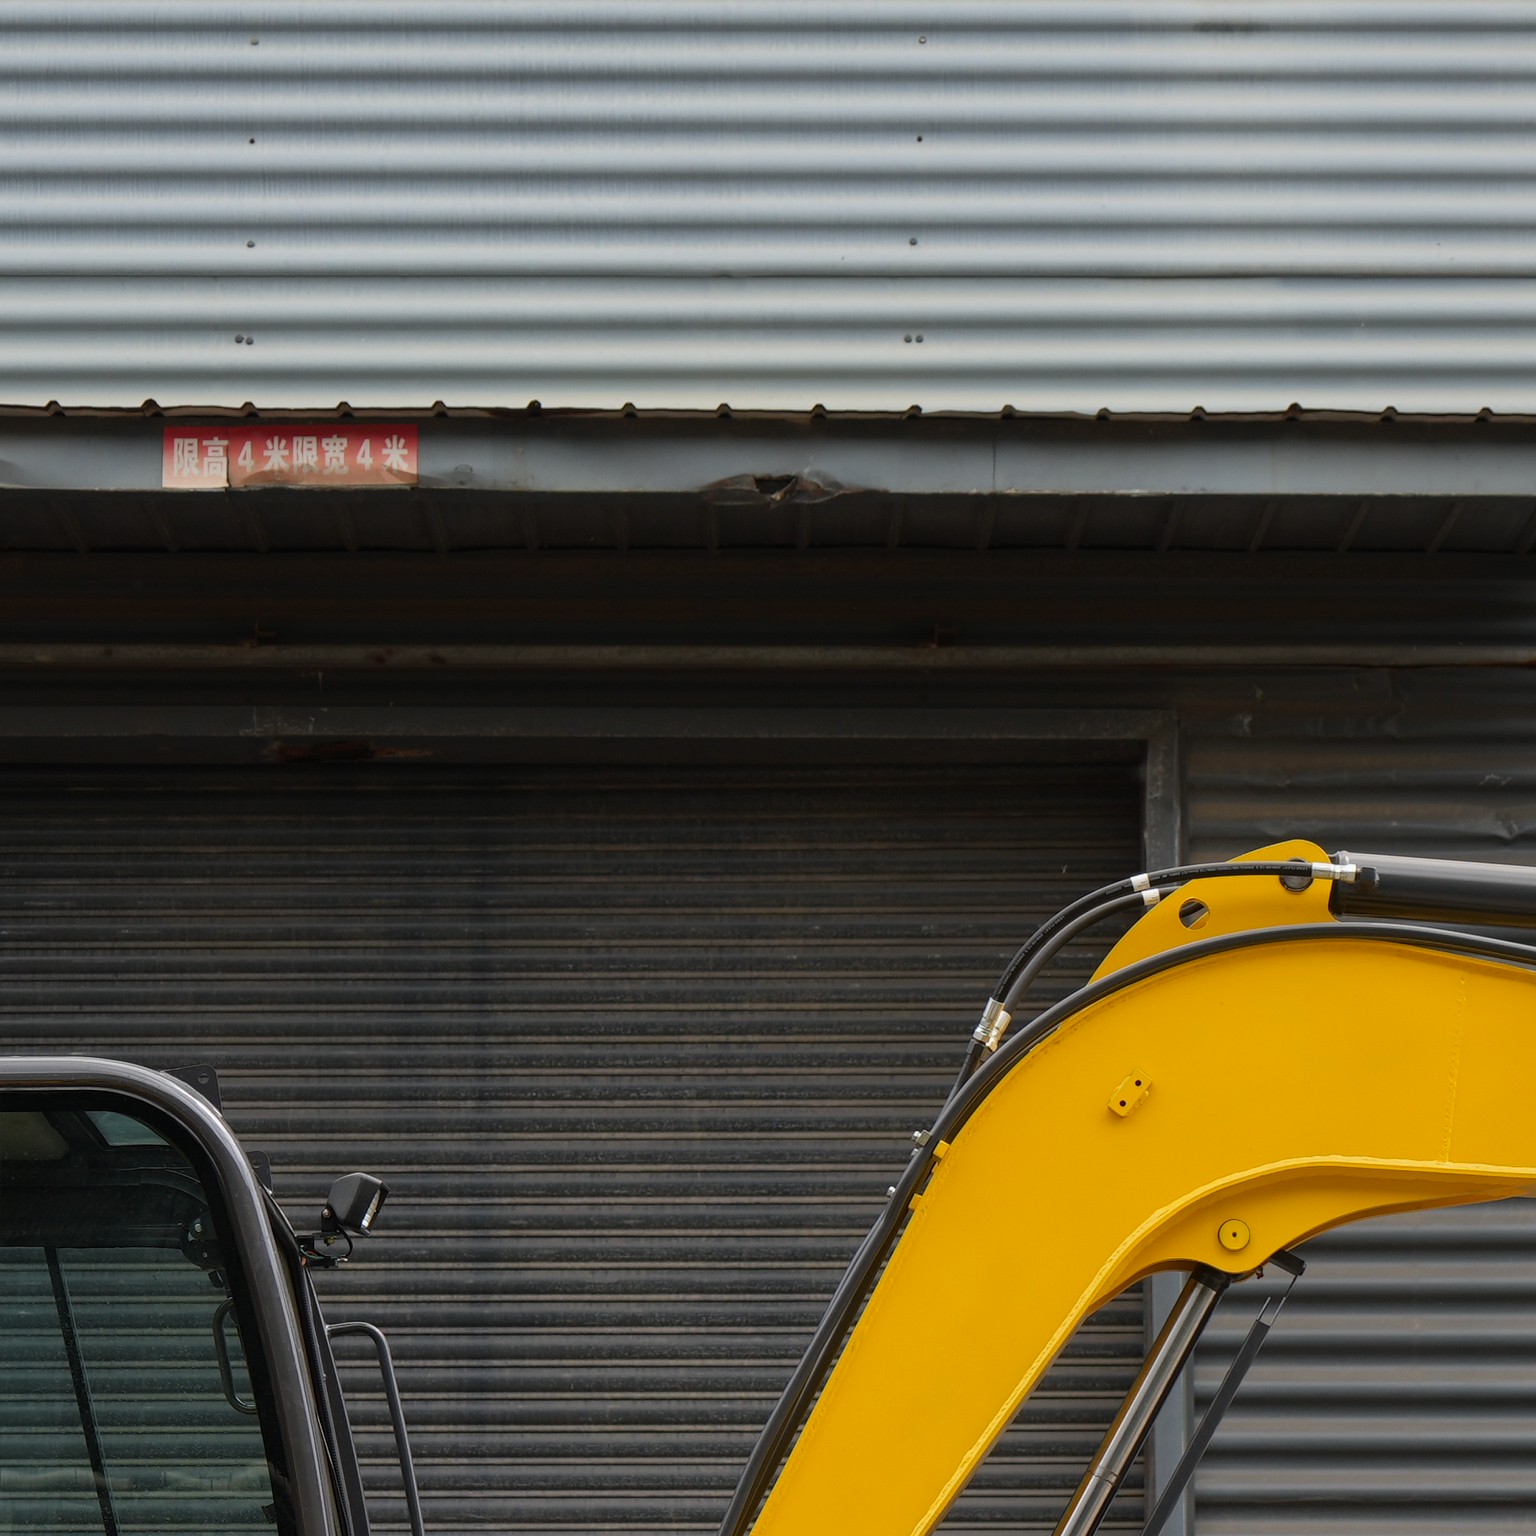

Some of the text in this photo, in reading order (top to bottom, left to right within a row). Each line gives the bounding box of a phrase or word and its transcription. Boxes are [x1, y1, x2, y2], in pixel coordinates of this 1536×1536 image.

[173, 434, 408, 477] 限高4米限宽4米
